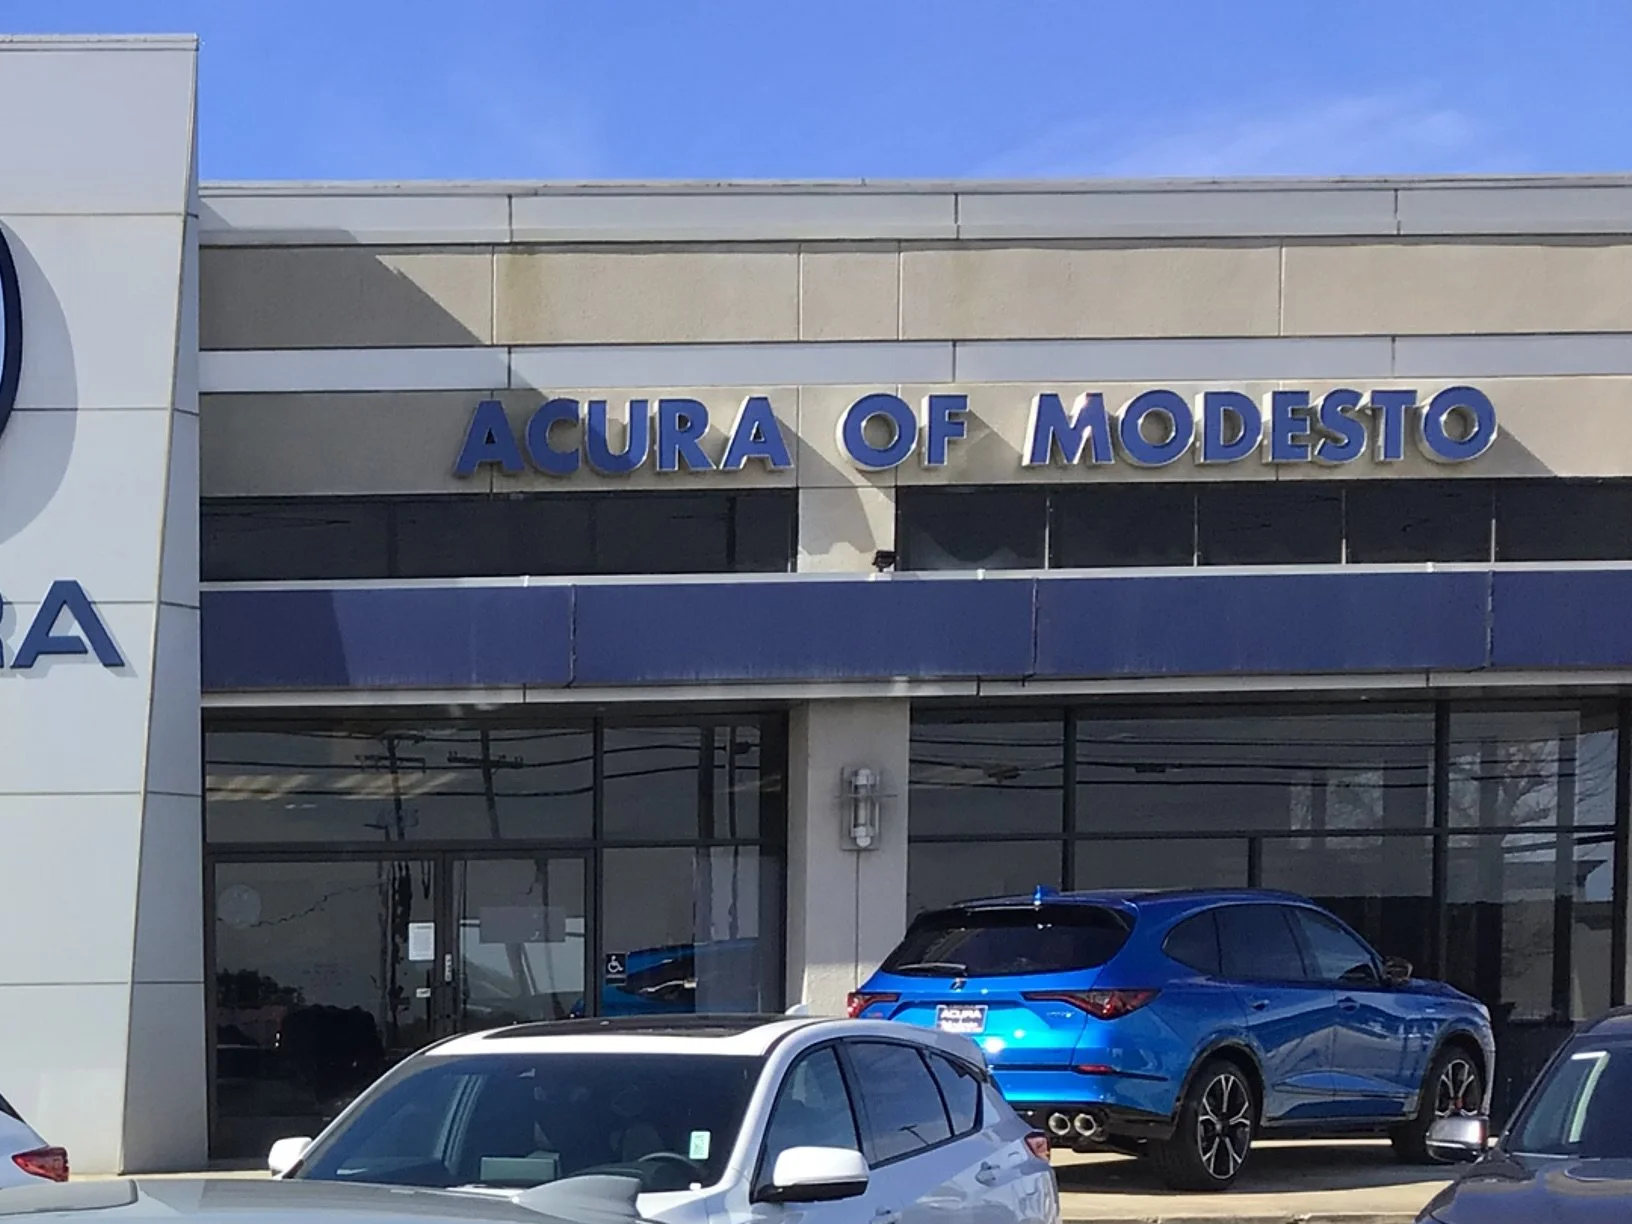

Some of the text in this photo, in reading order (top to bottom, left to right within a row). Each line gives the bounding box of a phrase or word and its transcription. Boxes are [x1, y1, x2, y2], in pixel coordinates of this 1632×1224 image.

[453, 386, 1498, 477] ACURA OF MODESTO
[940, 1008, 981, 1018] ACURA
